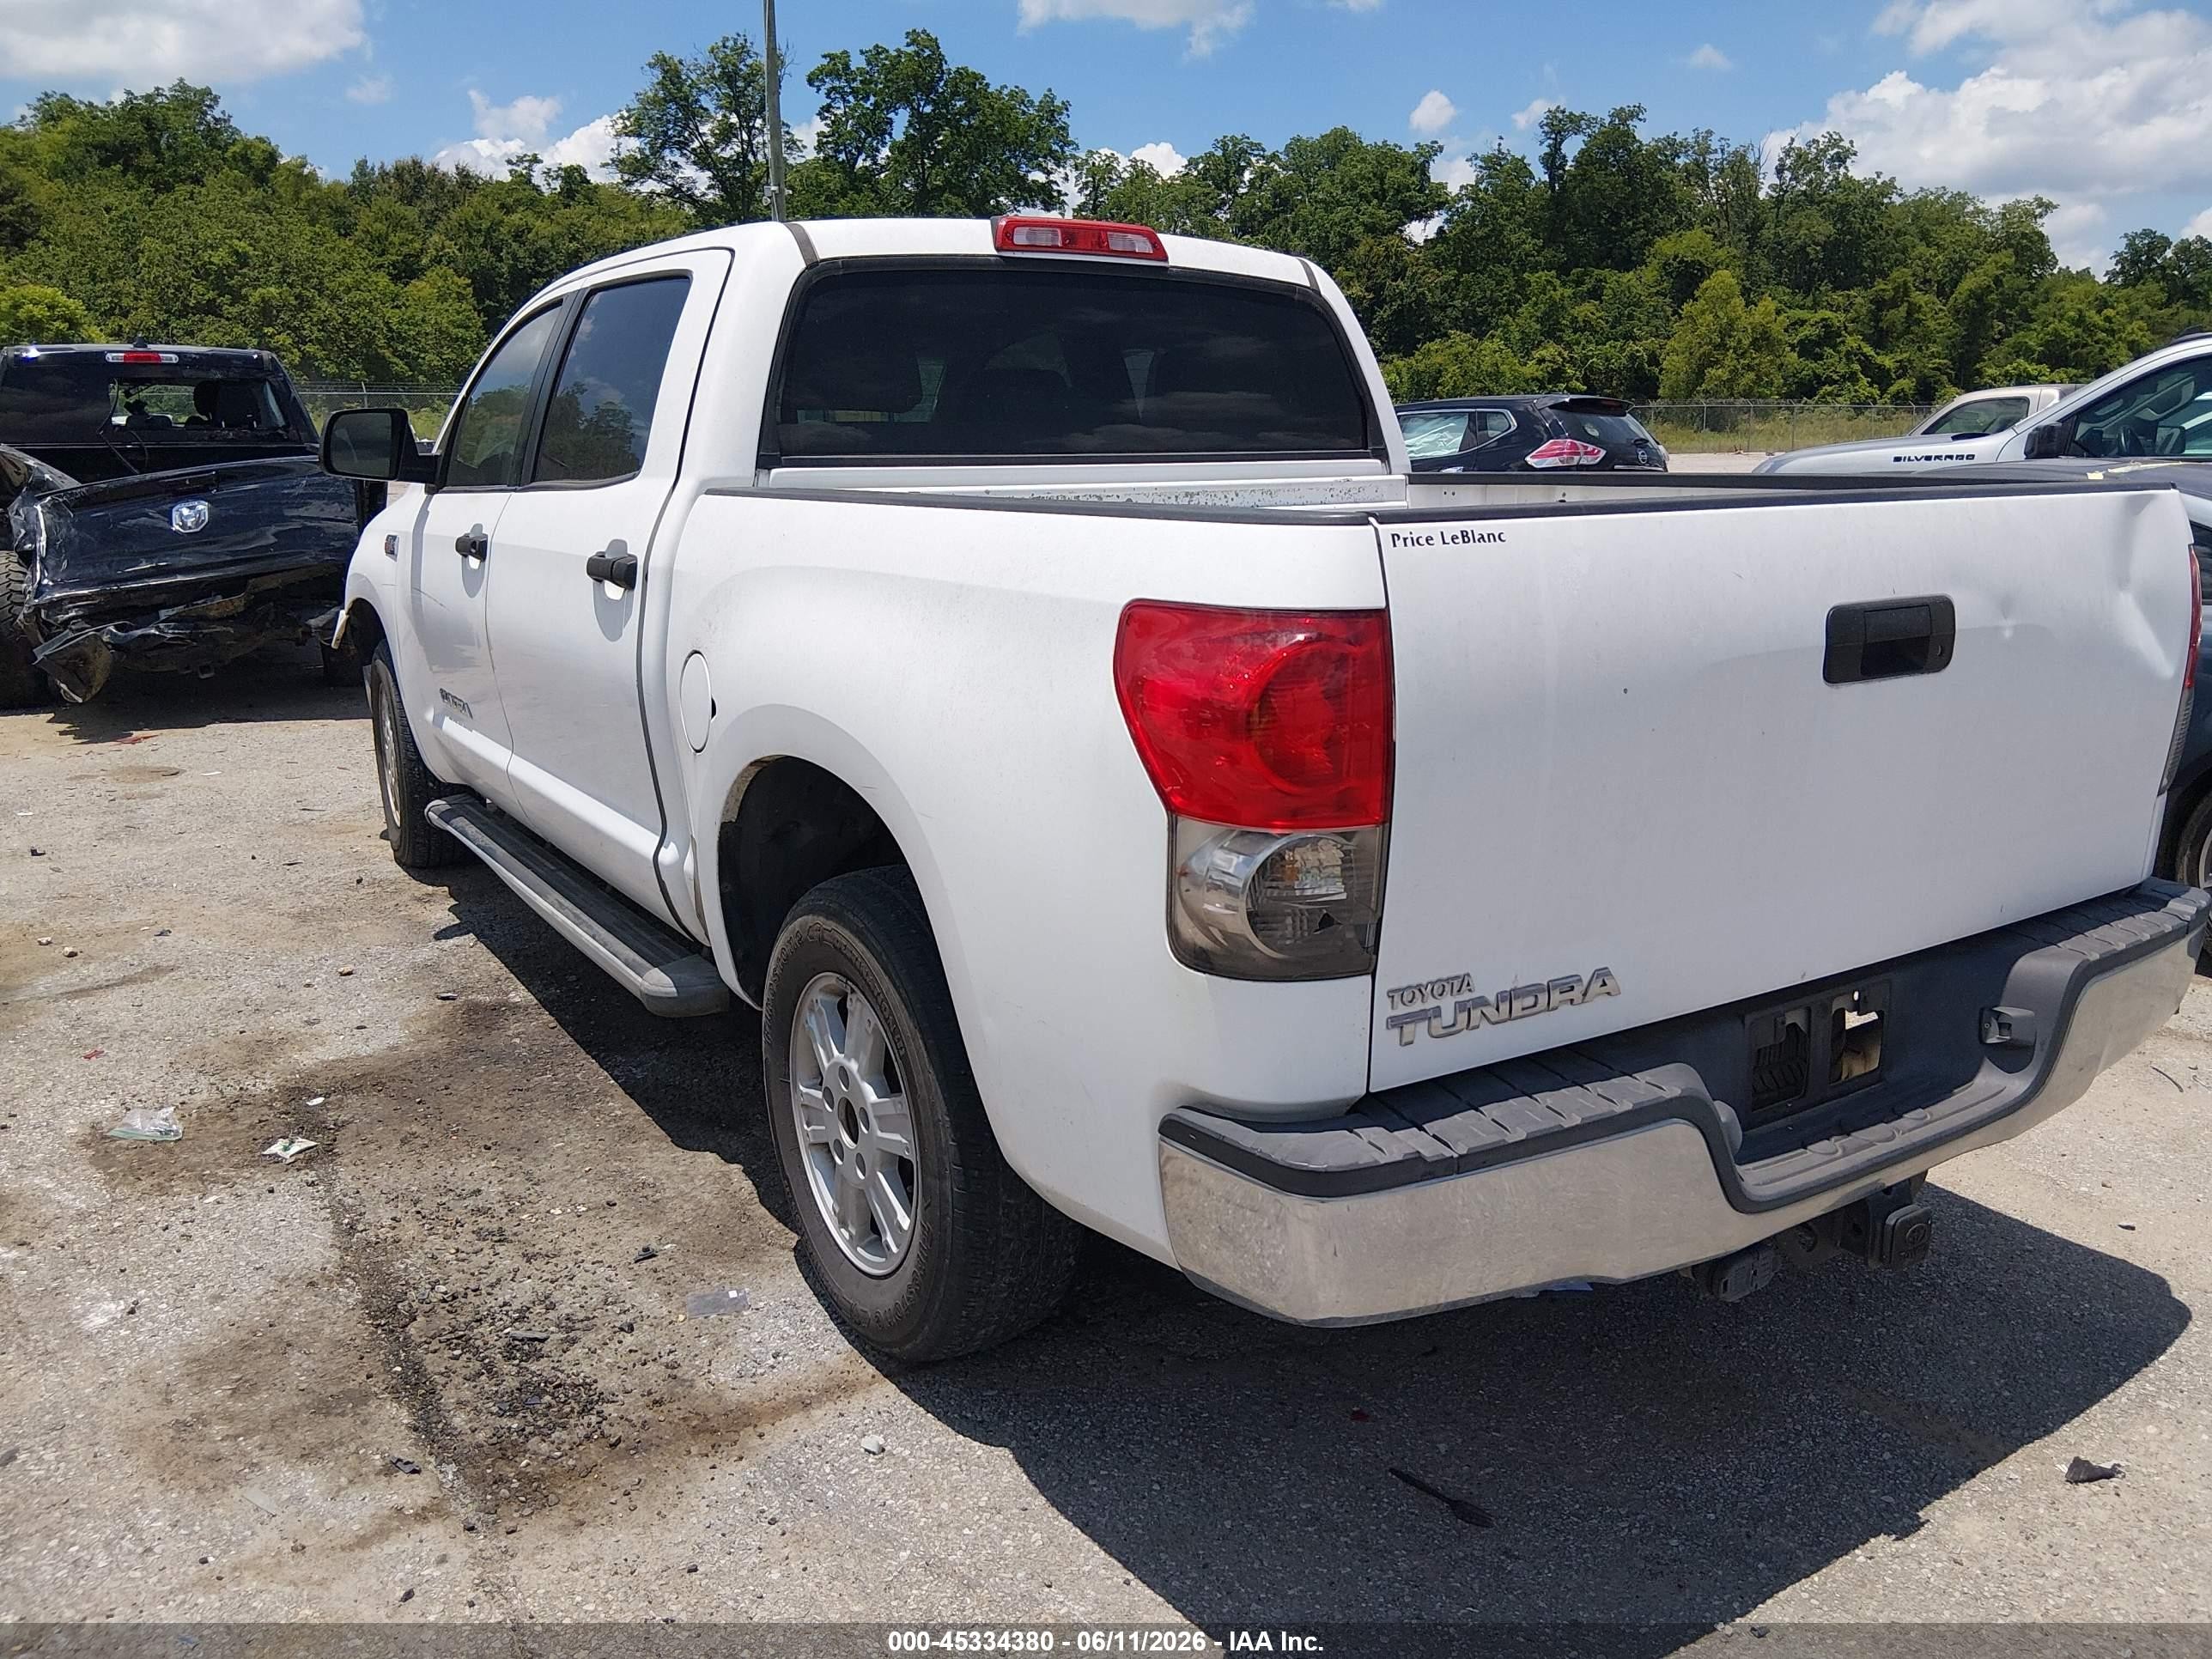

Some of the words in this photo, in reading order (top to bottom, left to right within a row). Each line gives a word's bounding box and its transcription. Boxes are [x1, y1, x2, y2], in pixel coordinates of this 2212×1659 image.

[1893, 453, 1976, 463] SILVERADO
[1390, 531, 1435, 548] Price
[1439, 529, 1507, 545] LeBlanc
[1387, 972, 1475, 1010] TOYOTA
[1386, 966, 1622, 1047] TUNDRA
